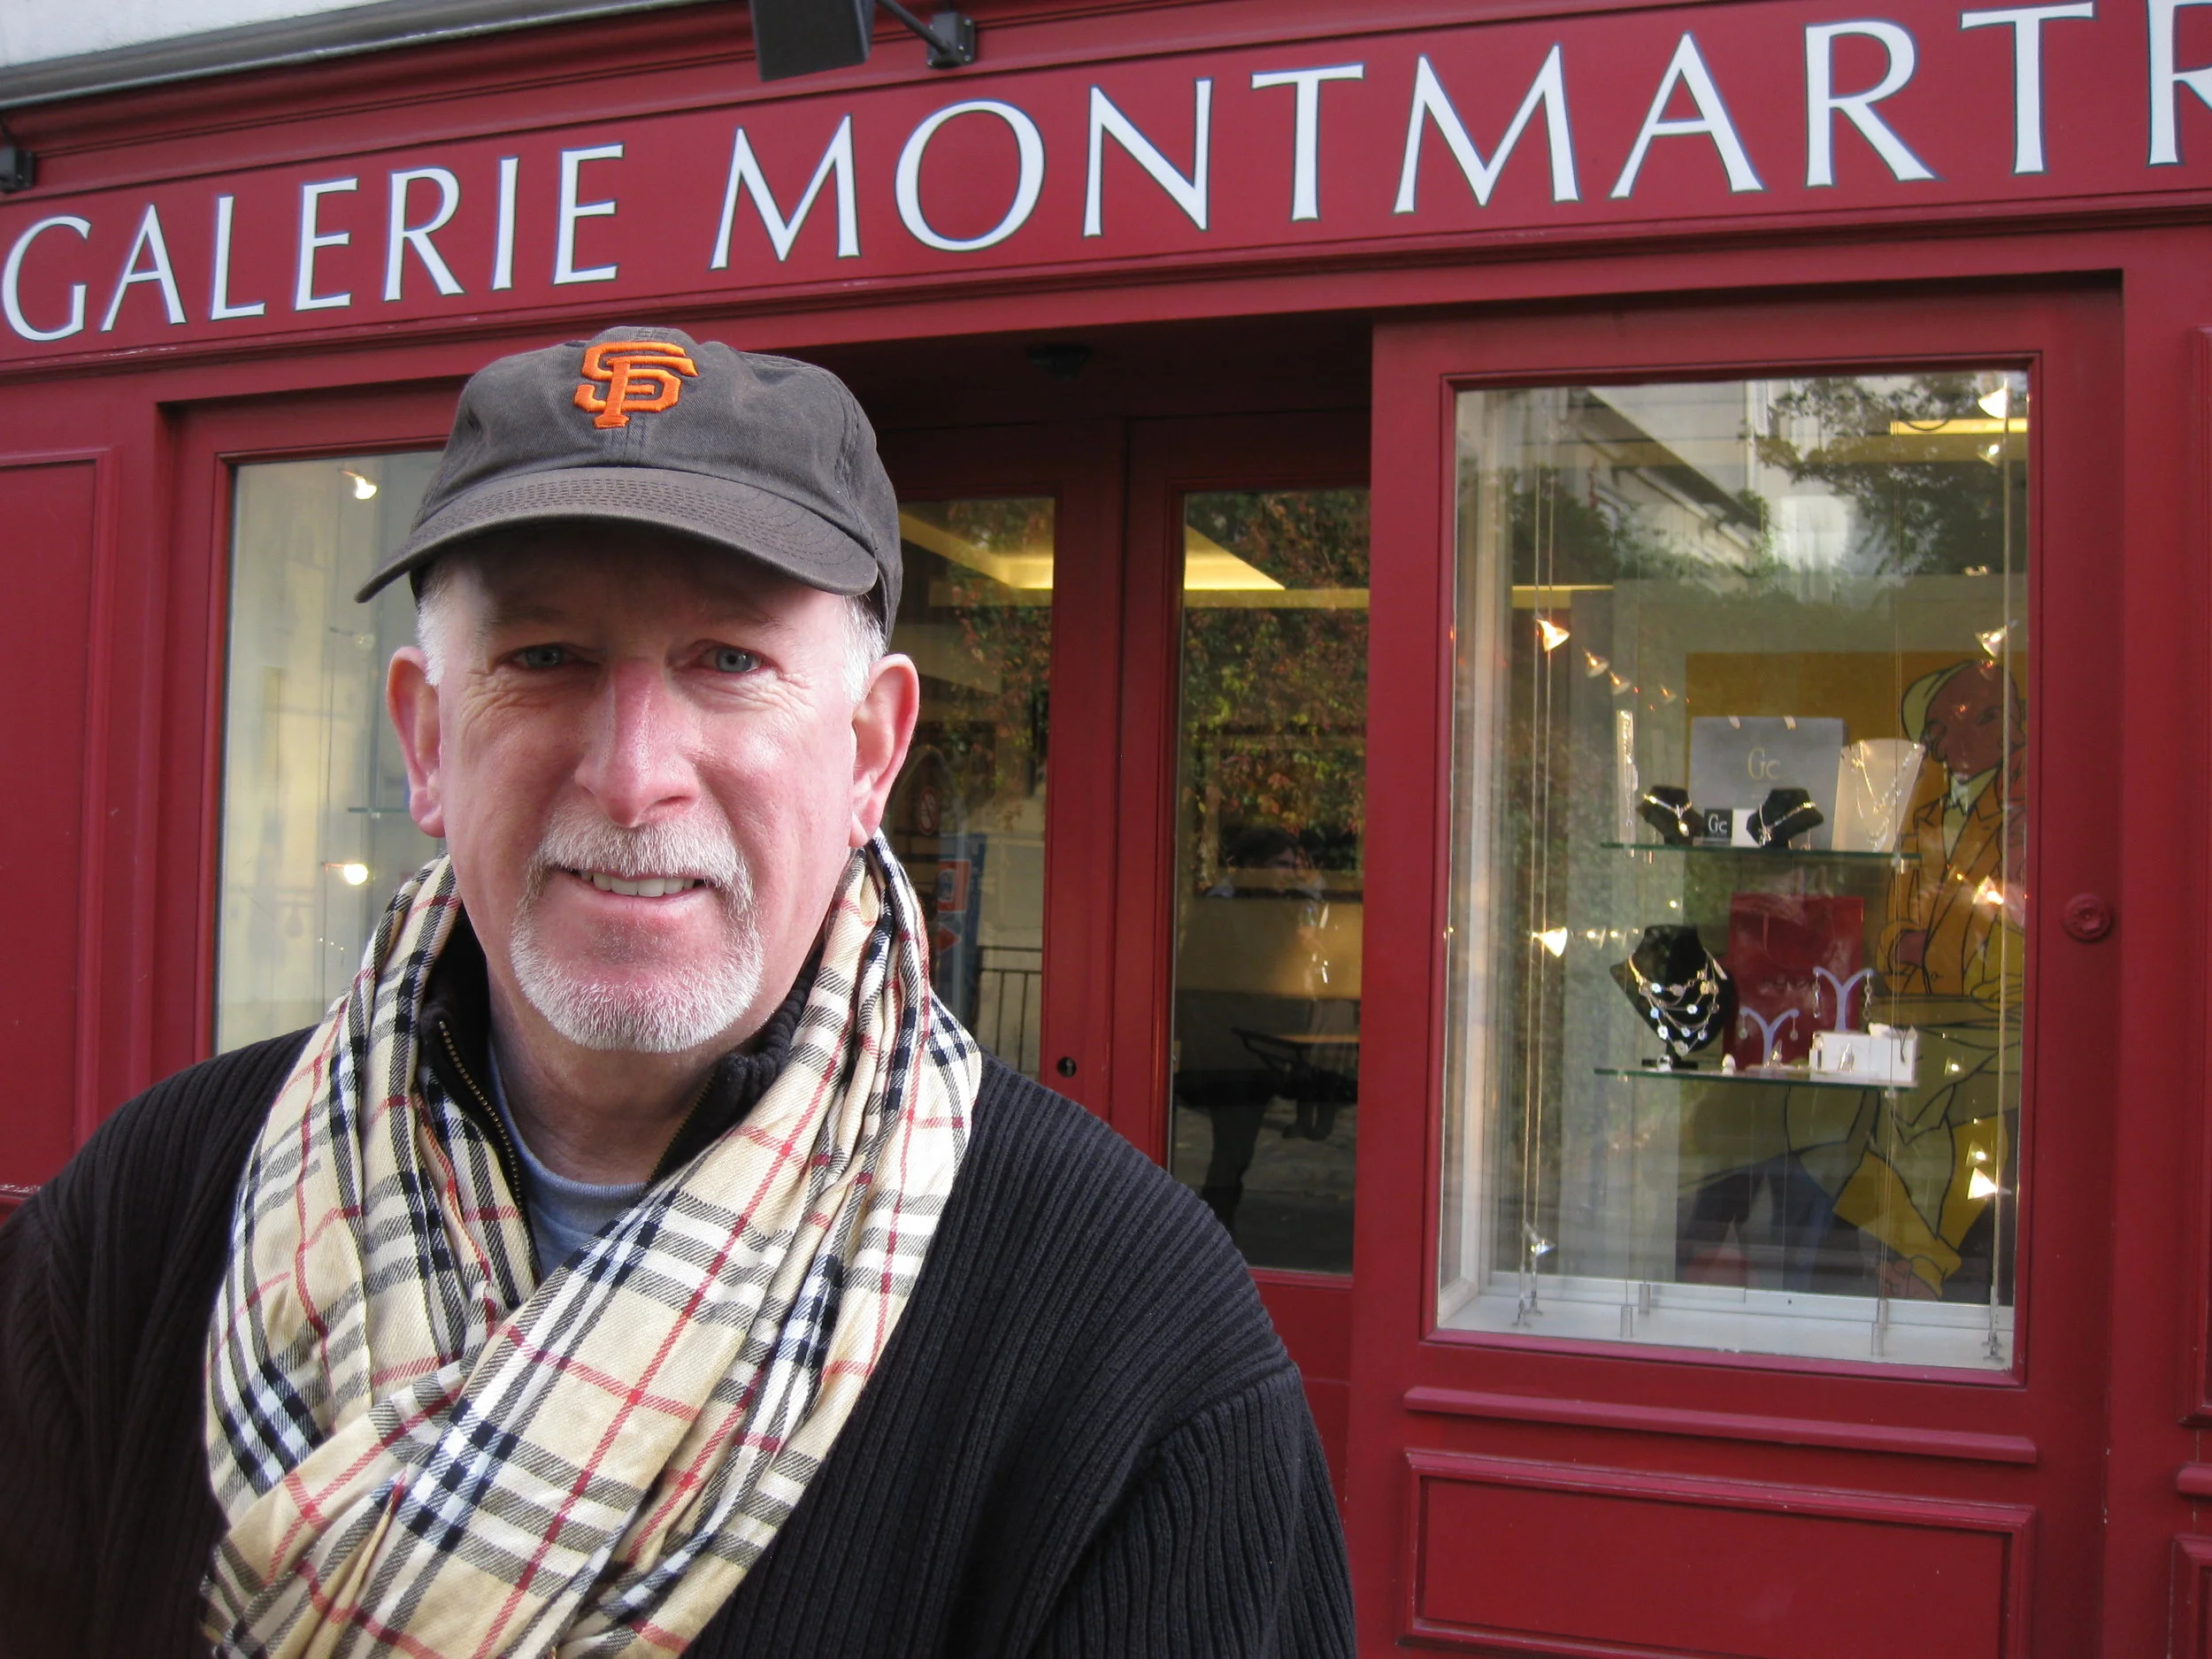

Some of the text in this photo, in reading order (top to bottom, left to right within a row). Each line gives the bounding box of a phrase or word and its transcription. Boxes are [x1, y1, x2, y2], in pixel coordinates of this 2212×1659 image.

[2, 142, 625, 342] GALERIE
[572, 340, 699, 430] SF
[1747, 746, 1781, 780] Gc
[1708, 813, 1728, 833] Gc
